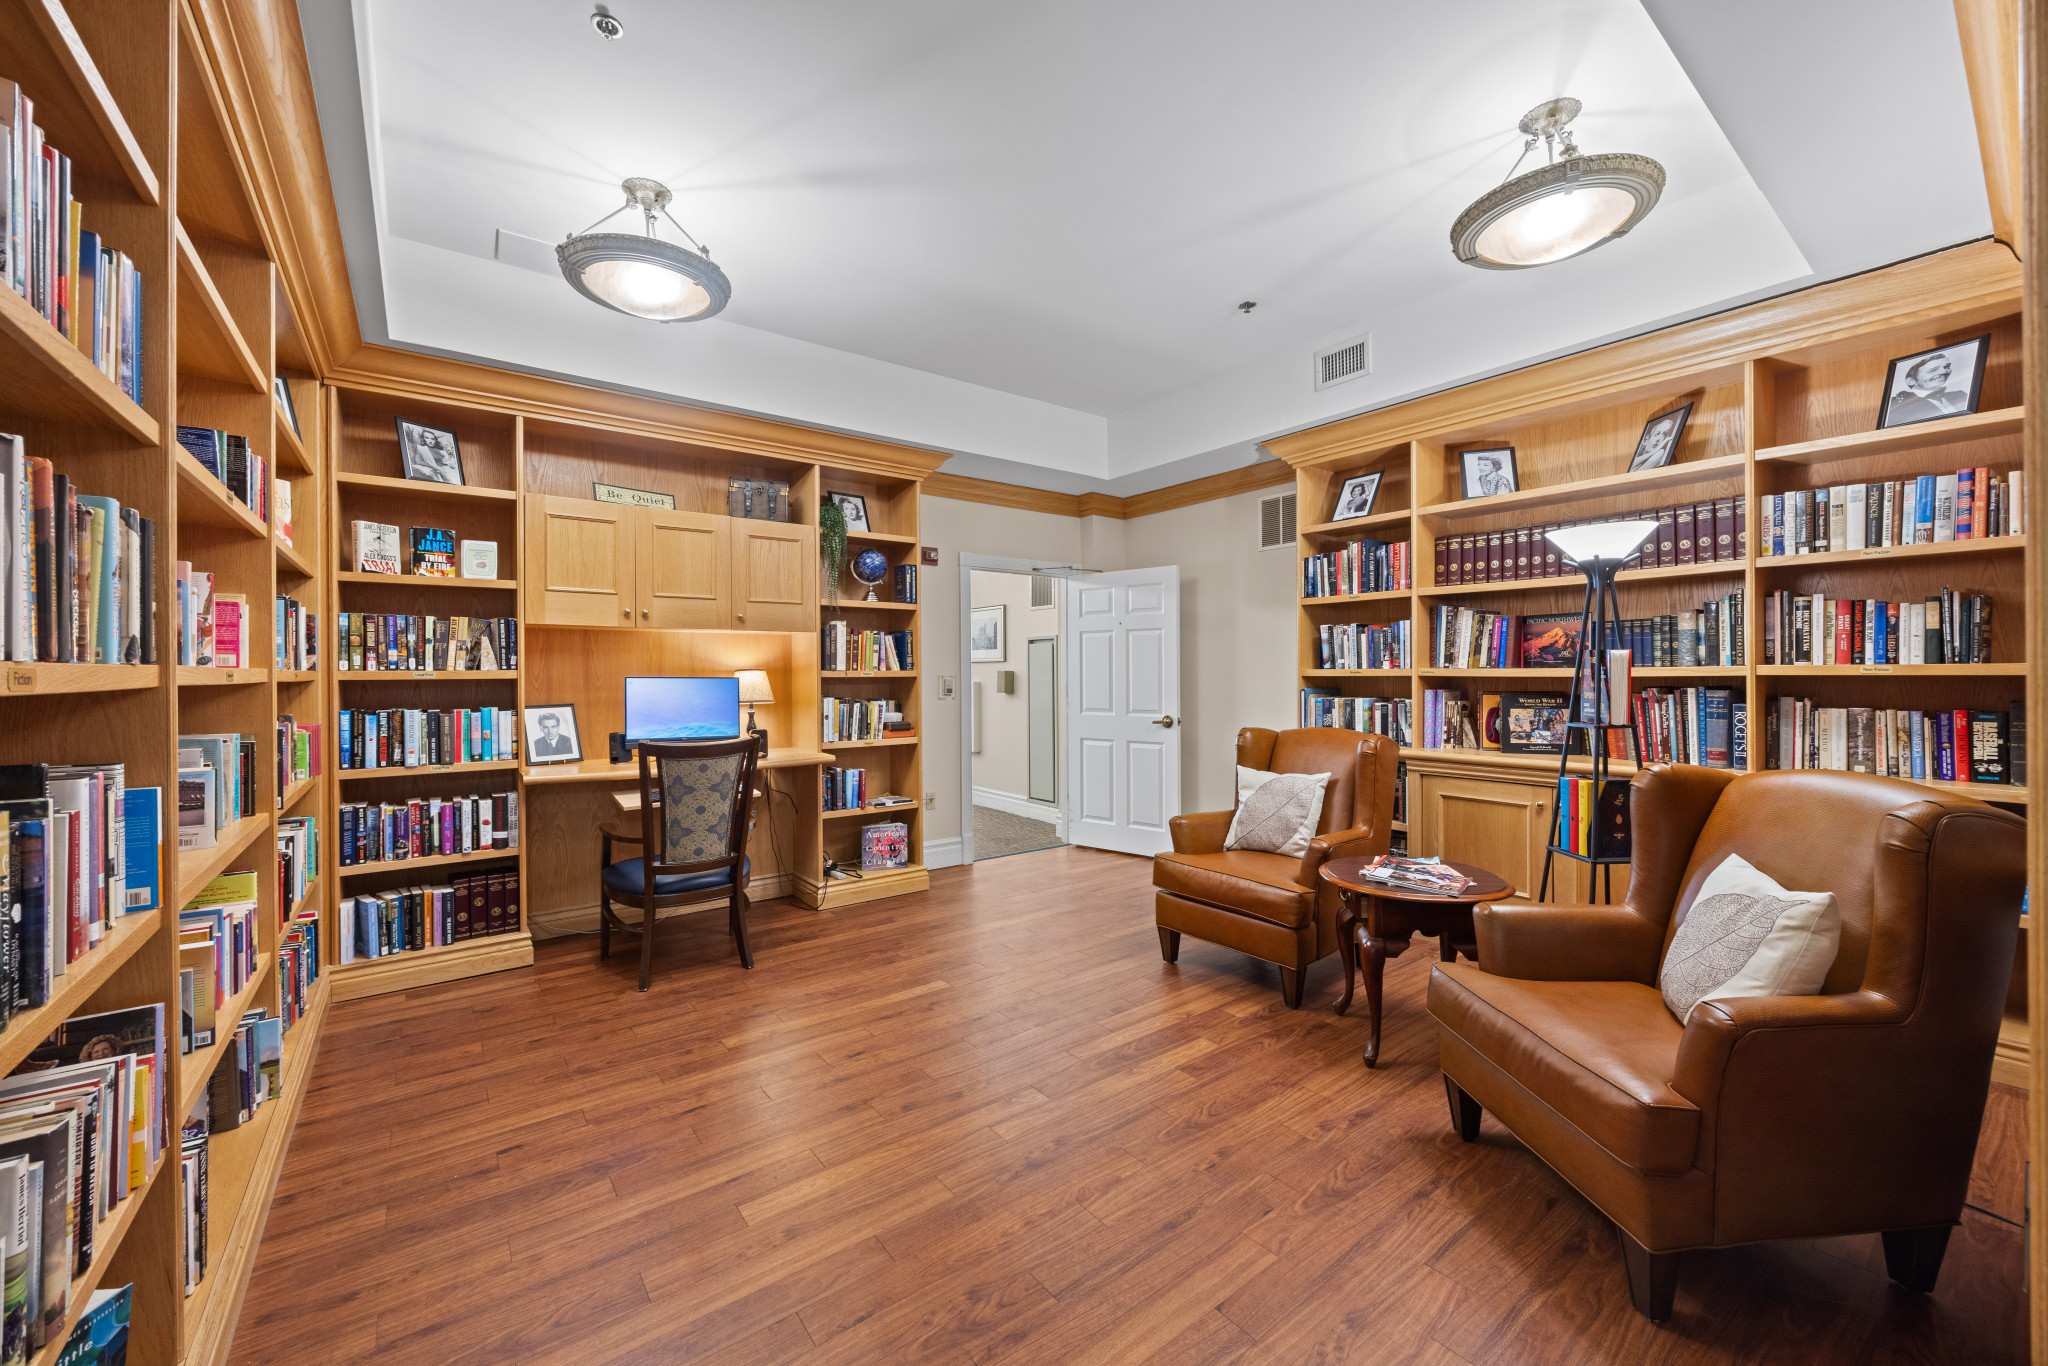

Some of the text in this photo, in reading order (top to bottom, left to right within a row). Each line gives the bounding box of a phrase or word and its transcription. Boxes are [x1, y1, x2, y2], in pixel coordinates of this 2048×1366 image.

[27, 466, 36, 515] DALE
[607, 490, 666, 505] Be Quiet
[1870, 491, 1878, 518] PRINCE
[1942, 504, 1951, 520] FIELDS
[363, 522, 397, 534] JAMES PATTERSON
[426, 528, 446, 541] J.A.
[1763, 515, 1771, 538] WALTERS
[364, 552, 377, 560] ALEX
[417, 540, 453, 553] JANCE
[363, 559, 398, 575] TRIAL
[421, 561, 452, 571] BY FIRE
[424, 554, 447, 563] TRIAL
[14, 672, 32, 685] Fiction
[1734, 711, 1746, 751] ROGET'S
[1973, 721, 1983, 760] ENCYCLOPEDIA
[1983, 721, 1998, 760] BASEBALL
[1913, 735, 1922, 757] AMERICA
[1958, 735, 1967, 764] DEMONIC
[866, 844, 905, 852] Country
[0, 854, 10, 973] Mayflower
[75, 1112, 83, 1165] McMURTRY
[17, 1174, 26, 1246] James Herriot
[84, 1299, 124, 1330] BESTSELLER
[57, 1340, 94, 1366] ittle
